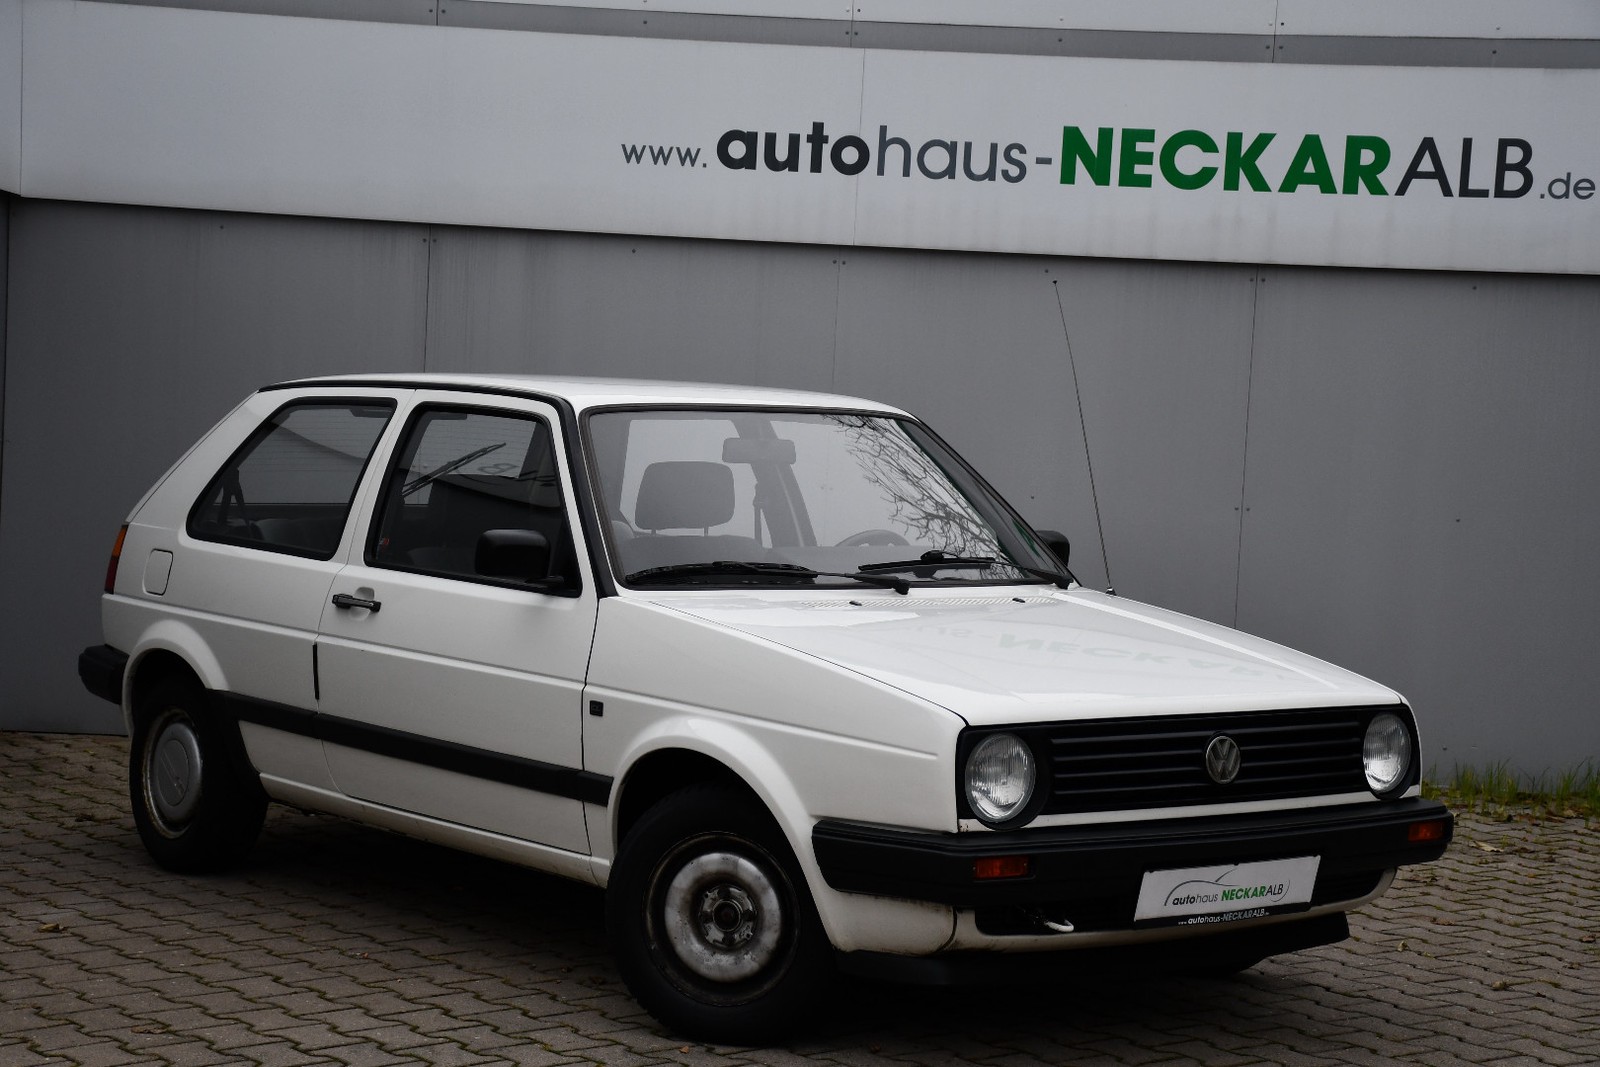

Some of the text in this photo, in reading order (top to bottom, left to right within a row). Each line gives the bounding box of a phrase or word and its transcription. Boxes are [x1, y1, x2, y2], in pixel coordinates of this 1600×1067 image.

[621, 121, 1596, 200] www.autohaus-NECKARALB.de
[1172, 883, 1284, 906] autohaus NECKARALB
